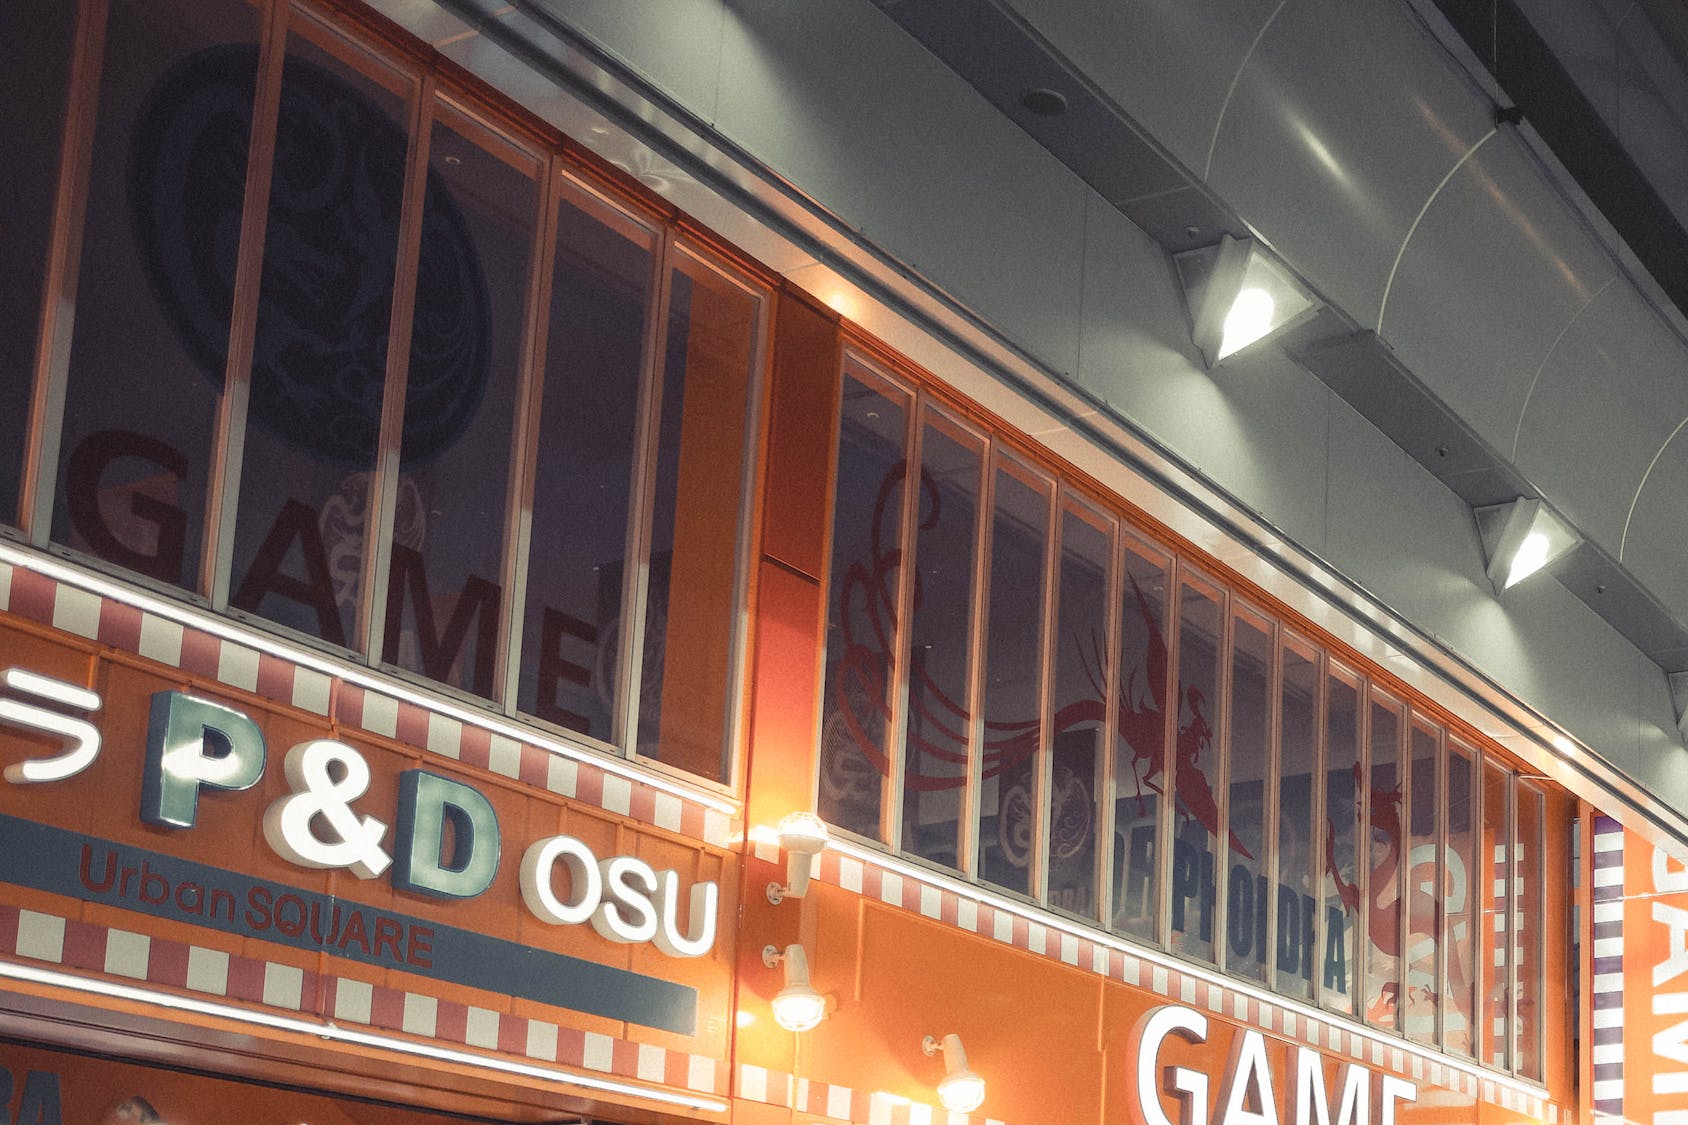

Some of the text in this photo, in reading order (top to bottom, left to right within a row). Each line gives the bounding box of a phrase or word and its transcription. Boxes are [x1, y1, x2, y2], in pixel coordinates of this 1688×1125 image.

[66, 429, 601, 737] GAME
[78, 845, 436, 970] Urban SQUARE
[140, 690, 501, 898] P&D
[520, 835, 719, 958] OSU
